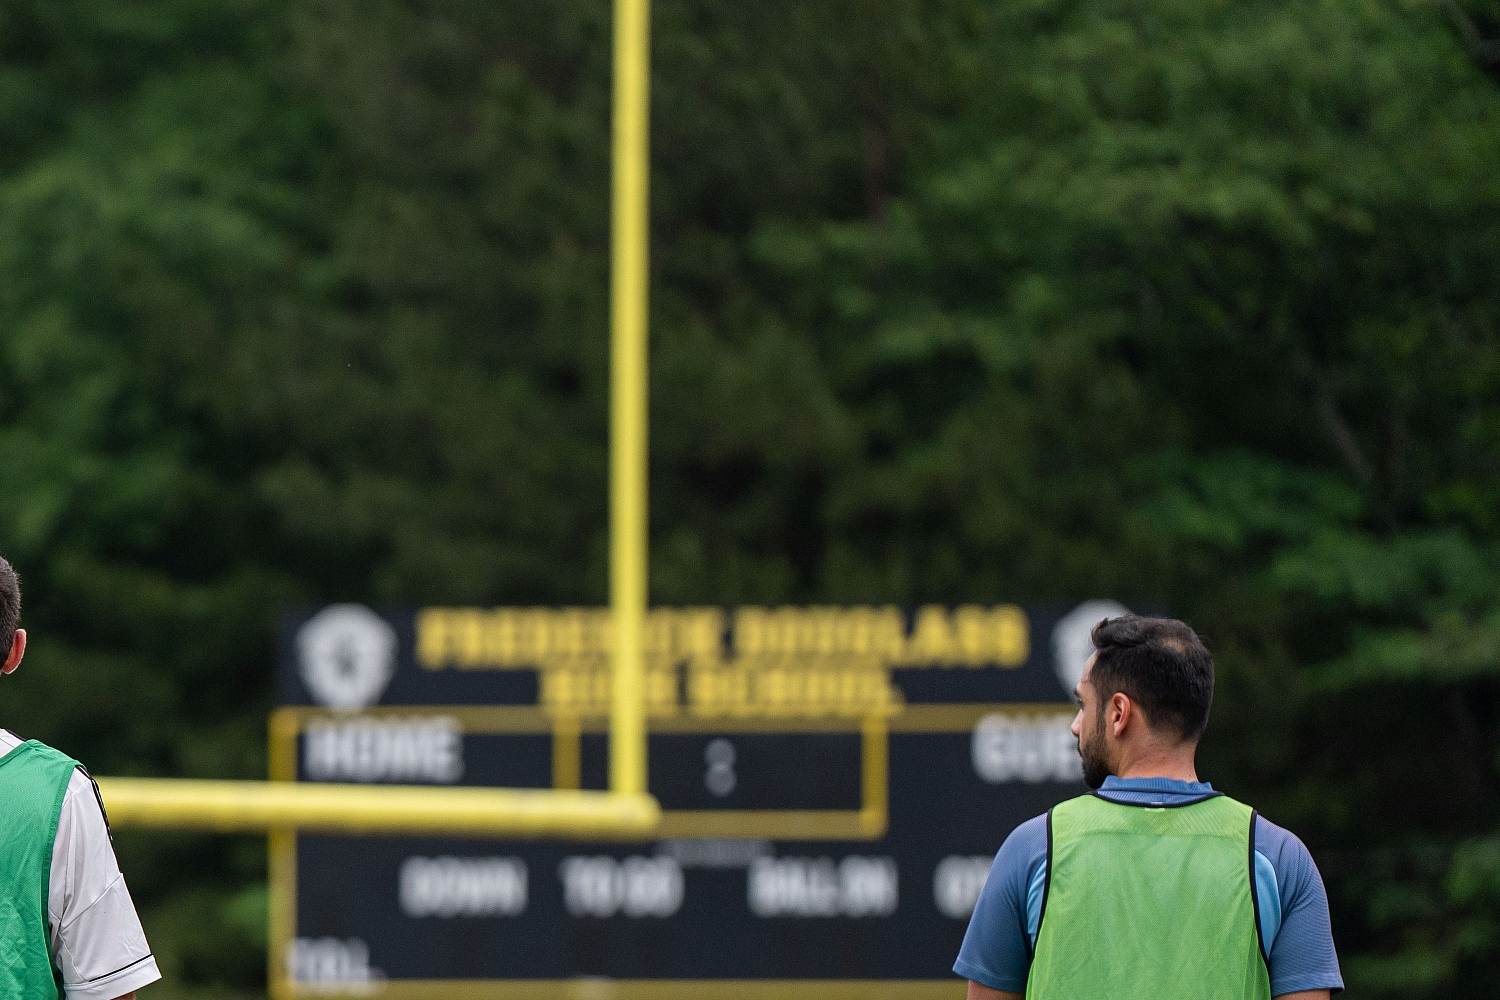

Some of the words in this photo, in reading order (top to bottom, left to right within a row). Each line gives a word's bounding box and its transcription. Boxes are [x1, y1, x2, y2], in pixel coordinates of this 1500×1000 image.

[417, 608, 721, 668] FREDERCK
[542, 671, 677, 716] HIH
[688, 669, 898, 717] SCHOOL
[305, 718, 464, 780] HOME
[973, 714, 1082, 781] GUE
[401, 858, 527, 915] DOWN
[562, 858, 618, 915] TO
